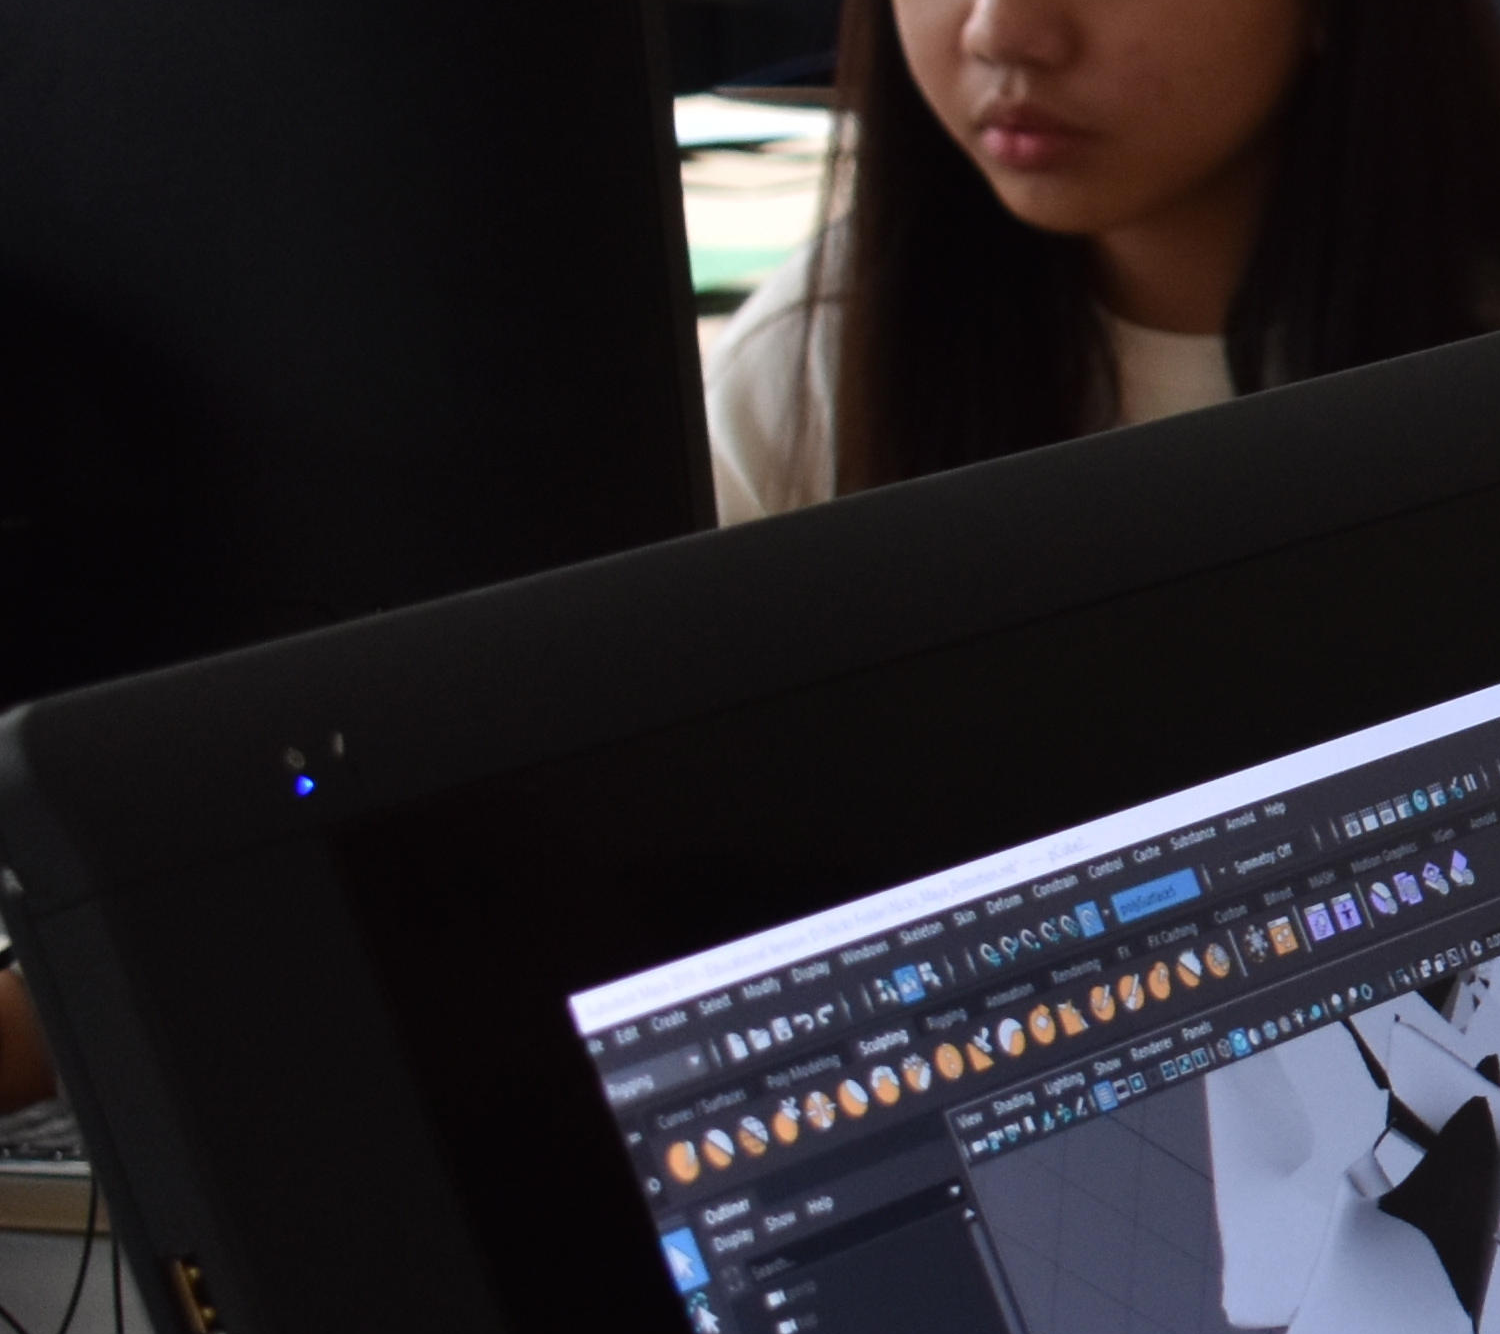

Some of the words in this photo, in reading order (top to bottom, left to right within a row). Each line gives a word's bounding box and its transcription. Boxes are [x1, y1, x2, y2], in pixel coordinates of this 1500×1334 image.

[1467, 809, 1499, 831] Arnold
[1232, 847, 1279, 877] Symmetry:
[1275, 841, 1294, 858] Off
[1349, 851, 1383, 874] Motion
[613, 1023, 641, 1045] Edit
[650, 1007, 689, 1033] Create
[697, 991, 733, 1016] Select
[741, 975, 783, 1003] Modify
[790, 958, 832, 987] Display
[840, 937, 891, 967] Windows
[898, 919, 945, 947] Skeleton
[952, 908, 978, 928] Skin
[984, 891, 1023, 916] Deform
[1031, 870, 1079, 899] Constrain
[1086, 854, 1124, 879] Control
[1131, 842, 1162, 864] Cache
[1169, 823, 1217, 850] Substance
[1223, 809, 1257, 832] Arnold
[1263, 799, 1287, 820] Help
[1212, 900, 1249, 925] Custom
[1159, 918, 1200, 947] Caching
[1050, 953, 1102, 987] Rendering
[983, 978, 1035, 1009] Animation
[925, 1003, 969, 1034] Rigging
[858, 1024, 911, 1059] Sculpting
[605, 1068, 655, 1102] Rigging
[765, 1069, 790, 1093] Poly
[786, 1050, 843, 1085] Modeling
[956, 1106, 985, 1131] View
[991, 1087, 1037, 1120] Shading
[1041, 1067, 1087, 1101] Lighting
[1093, 1053, 1123, 1078] Show
[1129, 1033, 1175, 1064] Renderer
[1181, 1018, 1214, 1044] Panels
[656, 1103, 696, 1130] Curves
[699, 1084, 748, 1114] Surfaces
[702, 1193, 752, 1227] Outliner
[712, 1223, 757, 1256] Display
[763, 1206, 798, 1233] Show
[806, 1192, 836, 1219] Help
